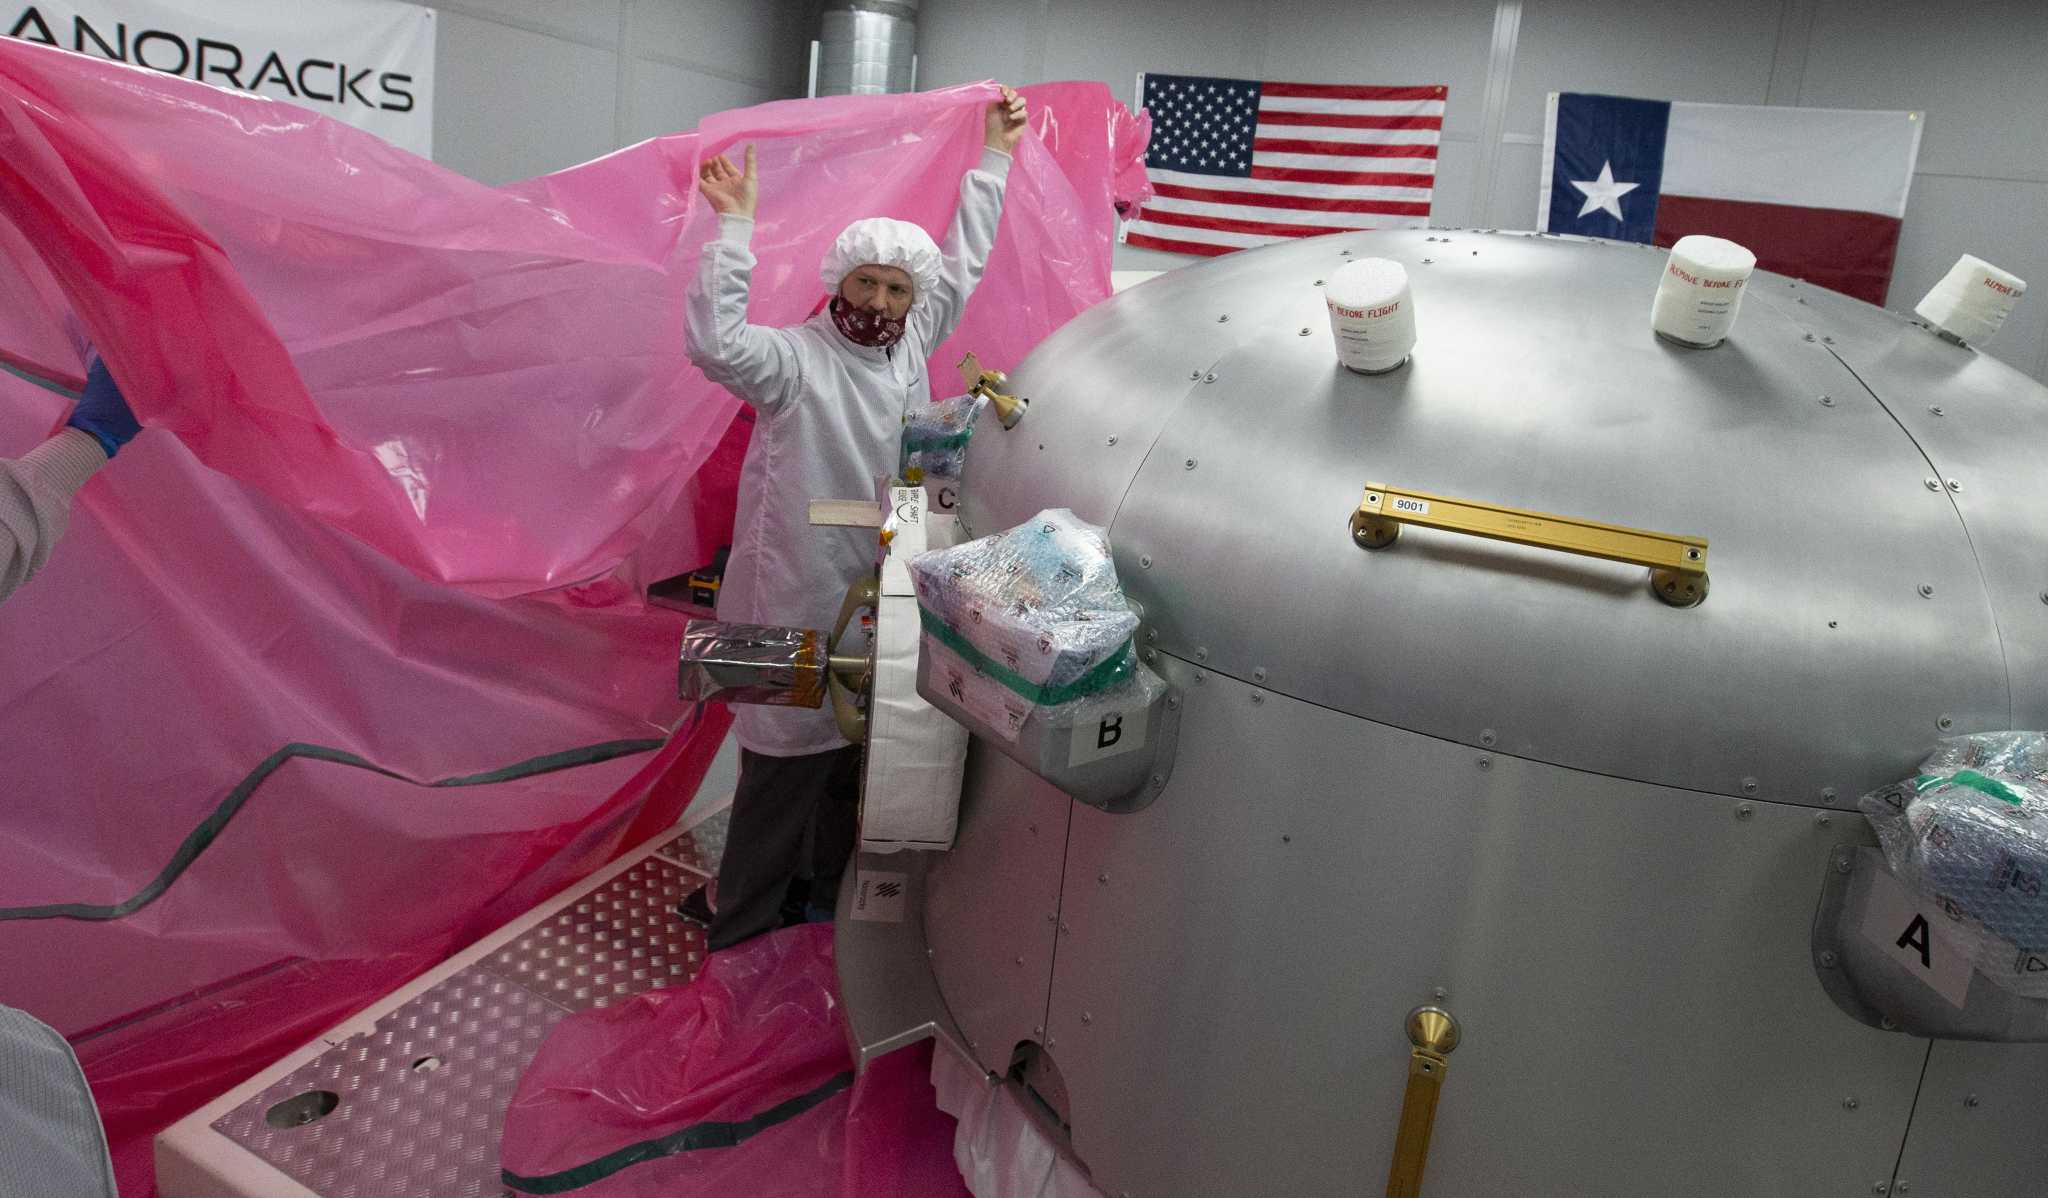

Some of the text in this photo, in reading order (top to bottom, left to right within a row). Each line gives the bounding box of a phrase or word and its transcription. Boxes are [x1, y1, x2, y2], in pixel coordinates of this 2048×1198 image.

[9, 6, 415, 113] ANORACKS
[1669, 264, 1698, 286] REMOVE
[1703, 279, 1732, 289] BEFORE
[1337, 306, 1365, 319] BEFORE
[1367, 301, 1400, 319] FLIGHT
[938, 487, 956, 509] C
[1397, 499, 1424, 512] 9001
[1097, 712, 1123, 749] B
[1896, 913, 1931, 969] A
